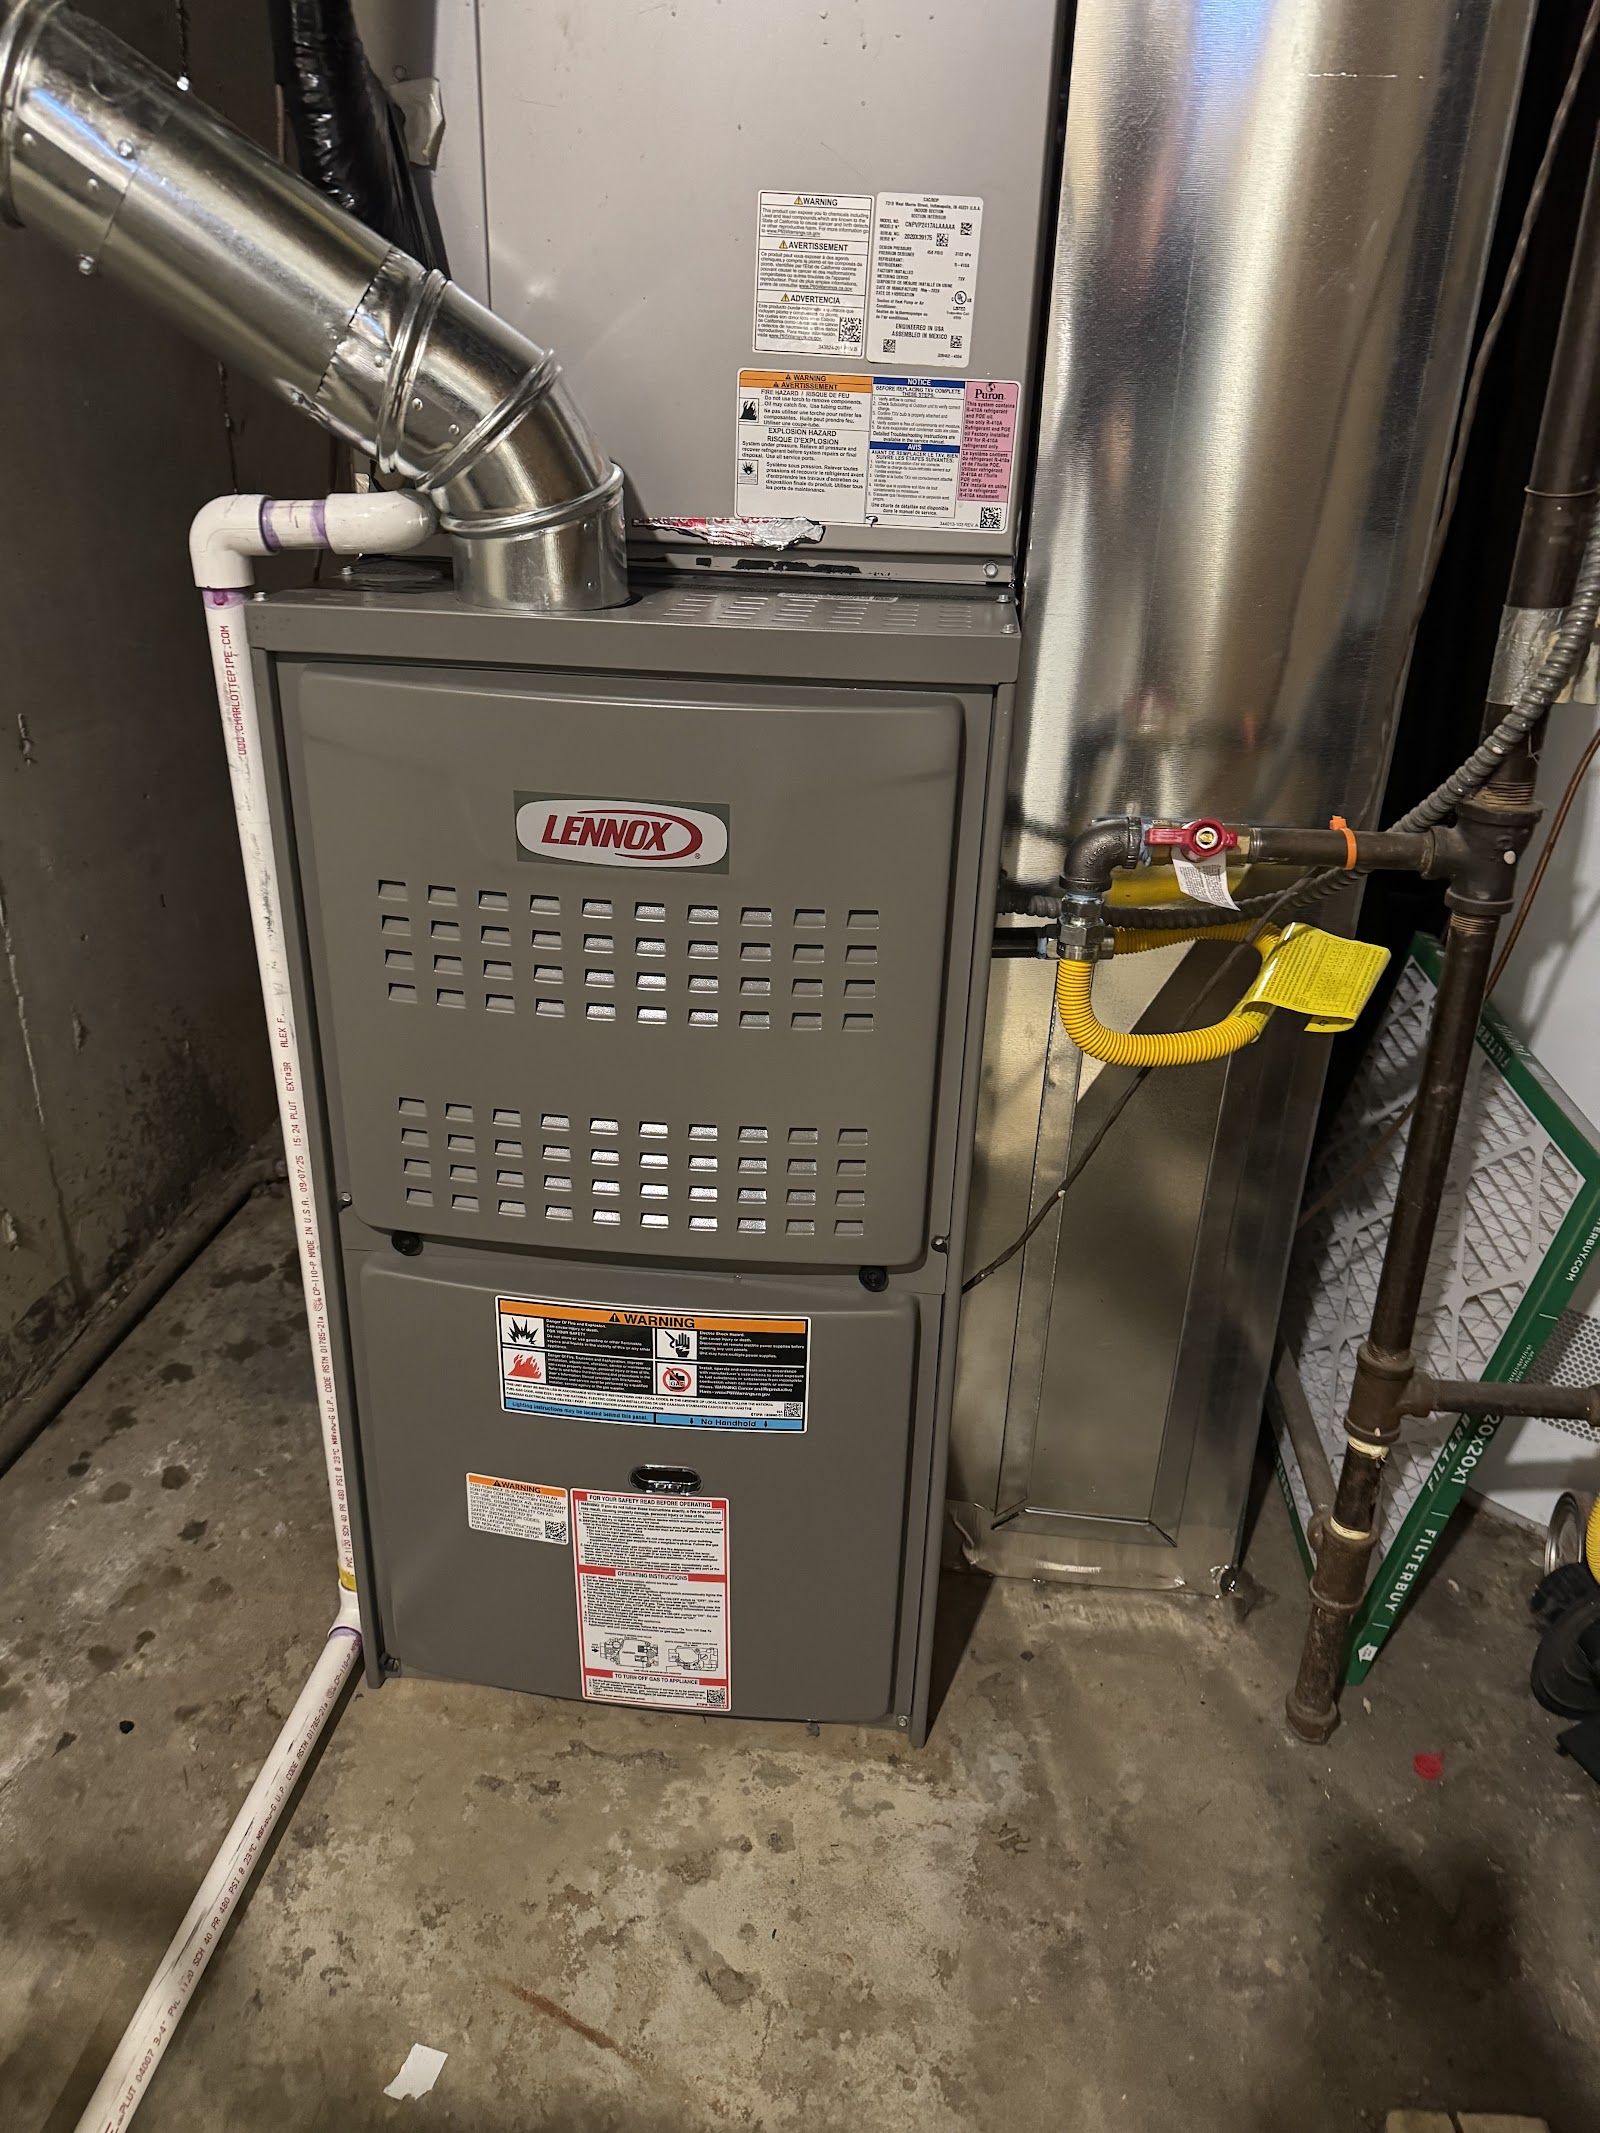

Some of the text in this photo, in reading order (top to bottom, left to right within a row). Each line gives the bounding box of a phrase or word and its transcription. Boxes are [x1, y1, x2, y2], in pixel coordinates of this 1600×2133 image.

[803, 198, 838, 206] WARNING
[789, 242, 848, 251] AVERTISSEMENT
[791, 295, 840, 304] ADVERTENCIA
[782, 382, 838, 390] AVERTISSEMENT
[975, 389, 1004, 400] Puron
[542, 814, 673, 851] LENNOX
[277, 1013, 285, 1024] F.
[278, 1027, 289, 1048] ALEX
[288, 1101, 298, 1120] PLUT
[296, 1155, 308, 1193] 09/07/25
[302, 1196, 312, 1224] U.S.A.
[305, 1226, 314, 1236] IN
[306, 1239, 316, 1258] MADE
[624, 1314, 695, 1328] WARNING
[322, 1356, 330, 1373] ASTM
[323, 1376, 332, 1392] CODE
[326, 1396, 334, 1412] U.P.
[336, 1475, 344, 1486] PSI
[502, 1482, 540, 1493] WARNING
[339, 1504, 346, 1512] PR
[1384, 1528, 1437, 1615] FILTERBUY
[118, 2086, 136, 2118] PLUT
[135, 2048, 154, 2083] 04007
[192, 1947, 205, 1967] SCH
[203, 1933, 213, 1945] 40
[211, 1916, 221, 1930] PR
[219, 1897, 230, 1914] 480
[228, 1877, 240, 1894] PSI
[276, 1785, 288, 1803] U.P.
[286, 1762, 299, 1781] CODE
[296, 1740, 309, 1760] ASTM
